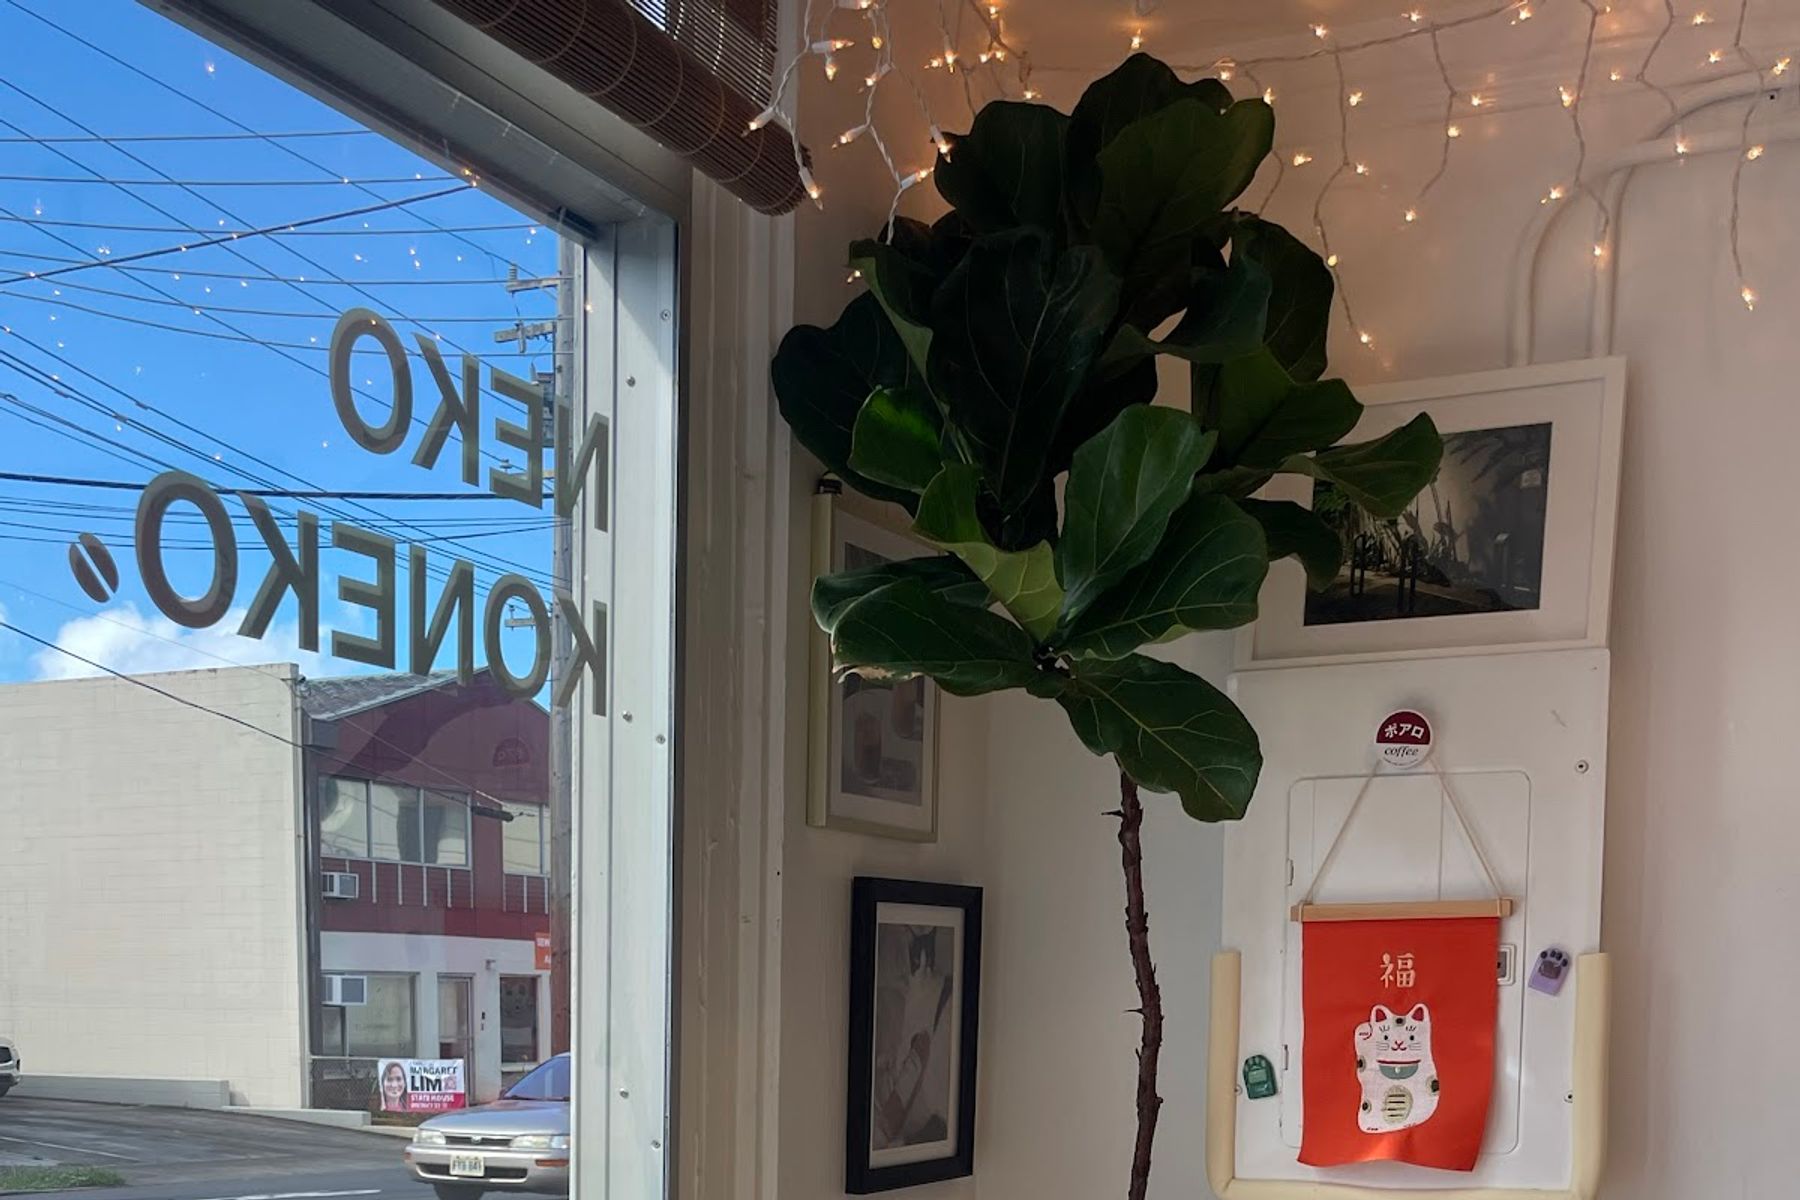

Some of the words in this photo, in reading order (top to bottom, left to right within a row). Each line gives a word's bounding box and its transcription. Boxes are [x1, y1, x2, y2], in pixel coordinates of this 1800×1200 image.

[1384, 722, 1425, 740] ポアロ
[1384, 745, 1420, 758] coffee
[1380, 952, 1416, 989] 福
[411, 1076, 442, 1092] LIM
